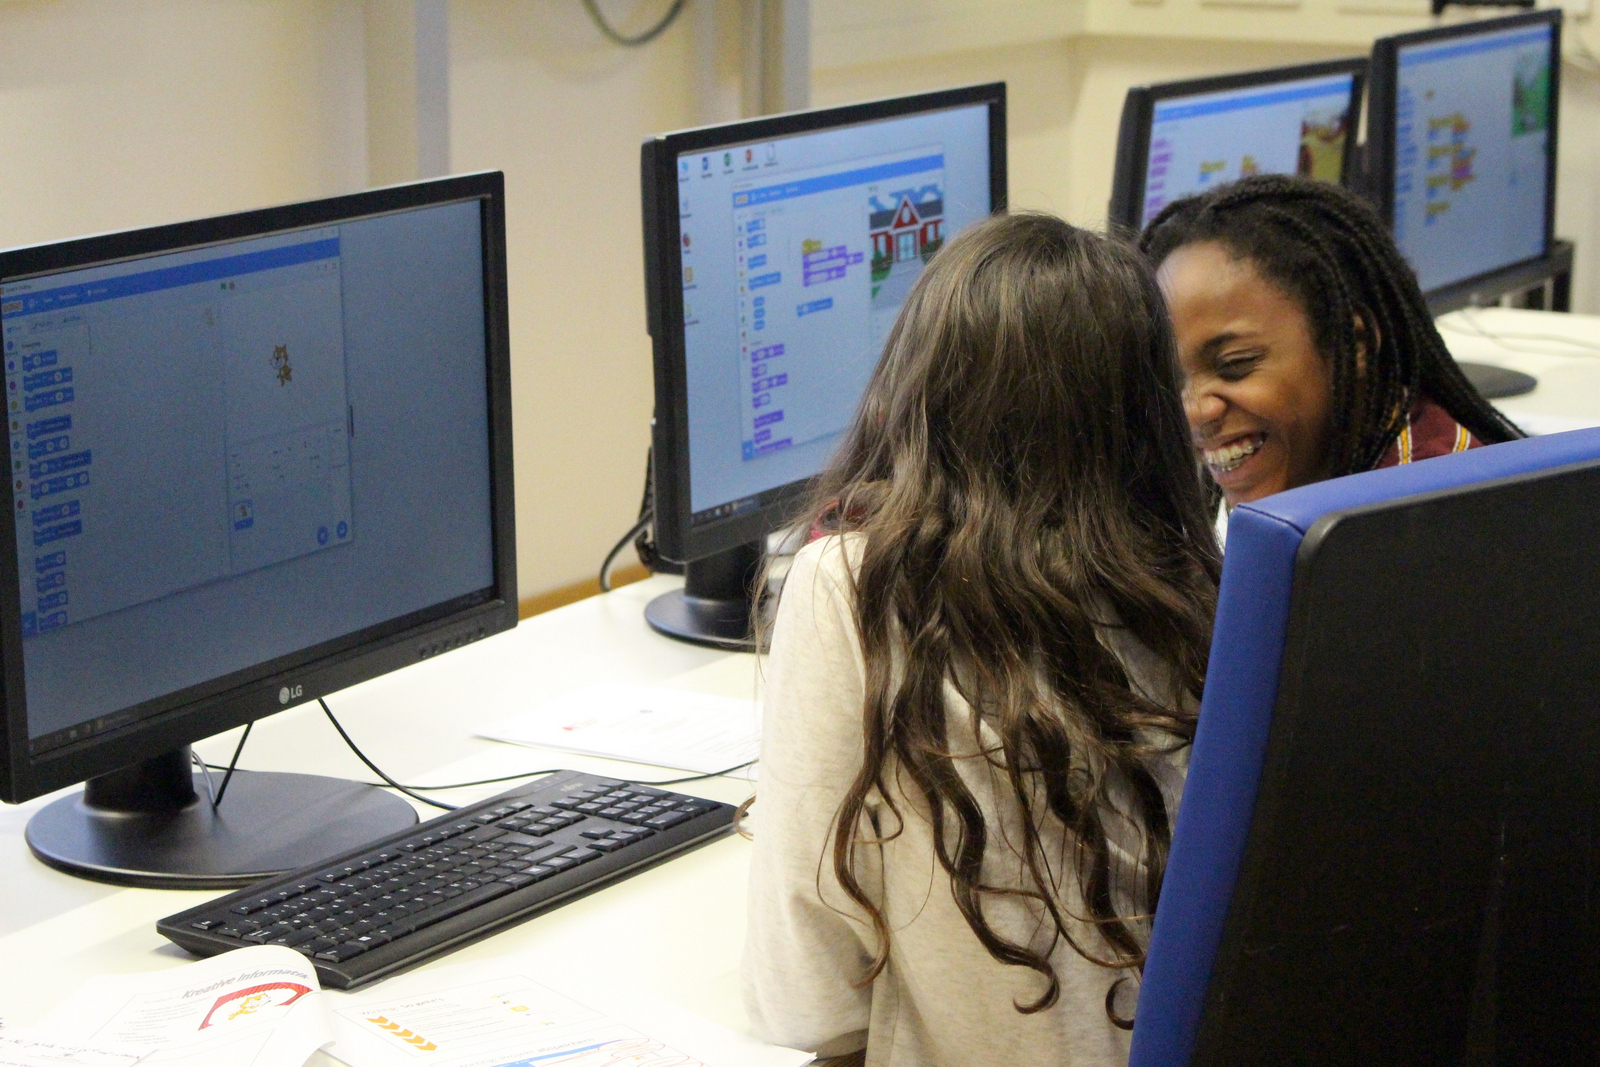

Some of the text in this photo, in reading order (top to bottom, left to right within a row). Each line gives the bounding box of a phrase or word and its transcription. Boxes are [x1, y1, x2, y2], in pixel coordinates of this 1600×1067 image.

[290, 684, 303, 699] LG
[182, 976, 236, 999] Kreative
[237, 969, 309, 982] Informatik
